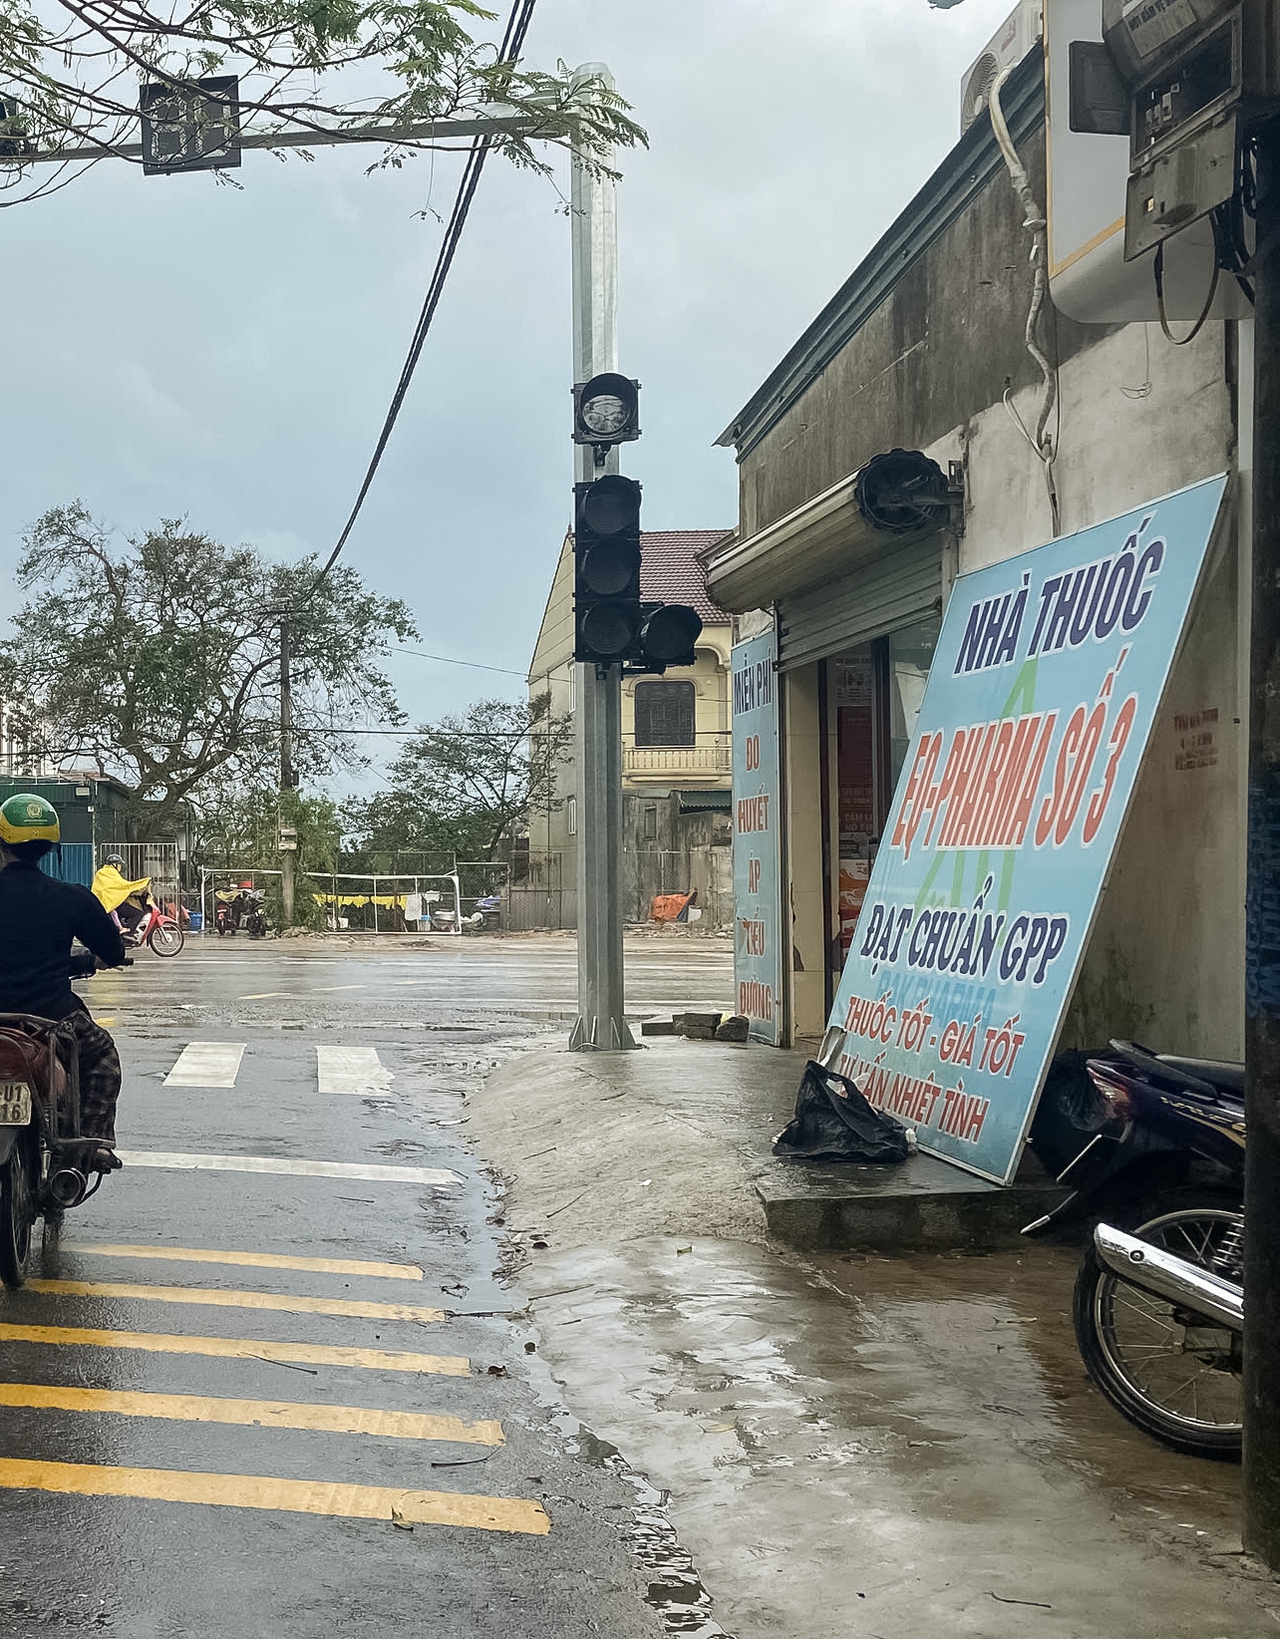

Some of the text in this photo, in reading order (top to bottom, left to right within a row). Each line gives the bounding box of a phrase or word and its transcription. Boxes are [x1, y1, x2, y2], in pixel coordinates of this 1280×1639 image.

[954, 517, 1163, 674] NHÀ THUỐC
[757, 648, 771, 708] PHÍ
[891, 648, 1137, 860] EQ-PHARMA SỐ 3
[739, 785, 769, 833] HUYẾT
[748, 852, 760, 893] ÁP
[860, 875, 1068, 983] ĐẠT CHUẨN GPP
[844, 991, 896, 1043] THUỐC
[896, 998, 932, 1053] TỐT
[940, 1014, 981, 1066] GIÁ
[979, 1014, 1025, 1076] TỐT
[887, 1072, 941, 1132] NHIỆT
[938, 1080, 989, 1143] TÌNH
